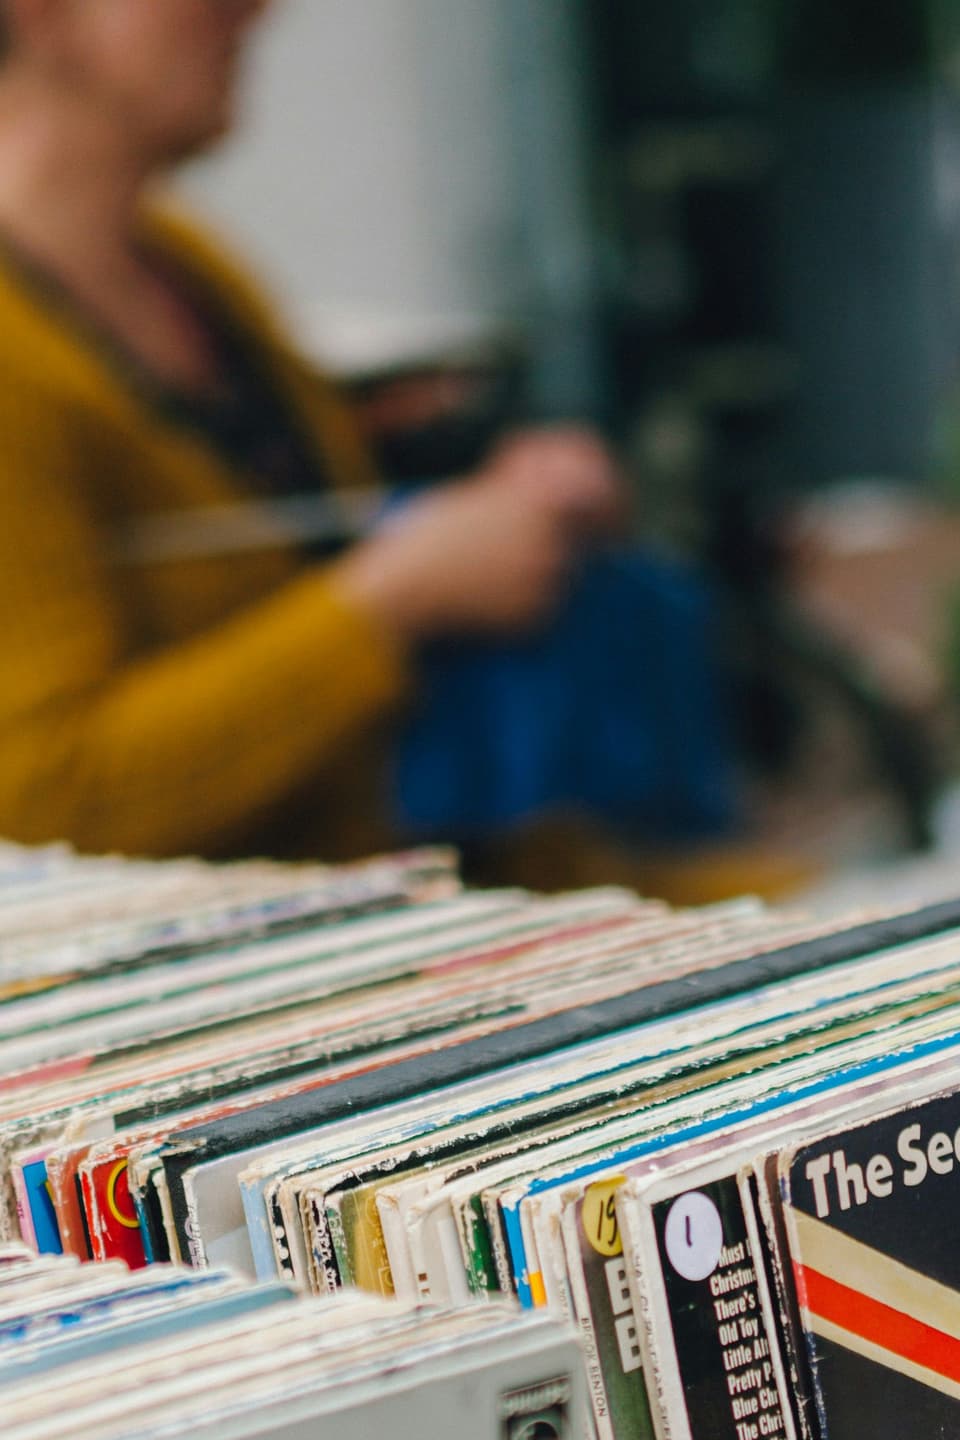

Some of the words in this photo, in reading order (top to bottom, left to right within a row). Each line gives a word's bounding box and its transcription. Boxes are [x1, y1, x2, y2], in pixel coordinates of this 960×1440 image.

[806, 1150, 894, 1218] The
[713, 1290, 756, 1321] There's
[718, 1320, 739, 1346] Old
[738, 1316, 759, 1338] Toy
[722, 1344, 752, 1371] Little
[726, 1368, 762, 1396] Pretty
[731, 1396, 759, 1421] Blue
